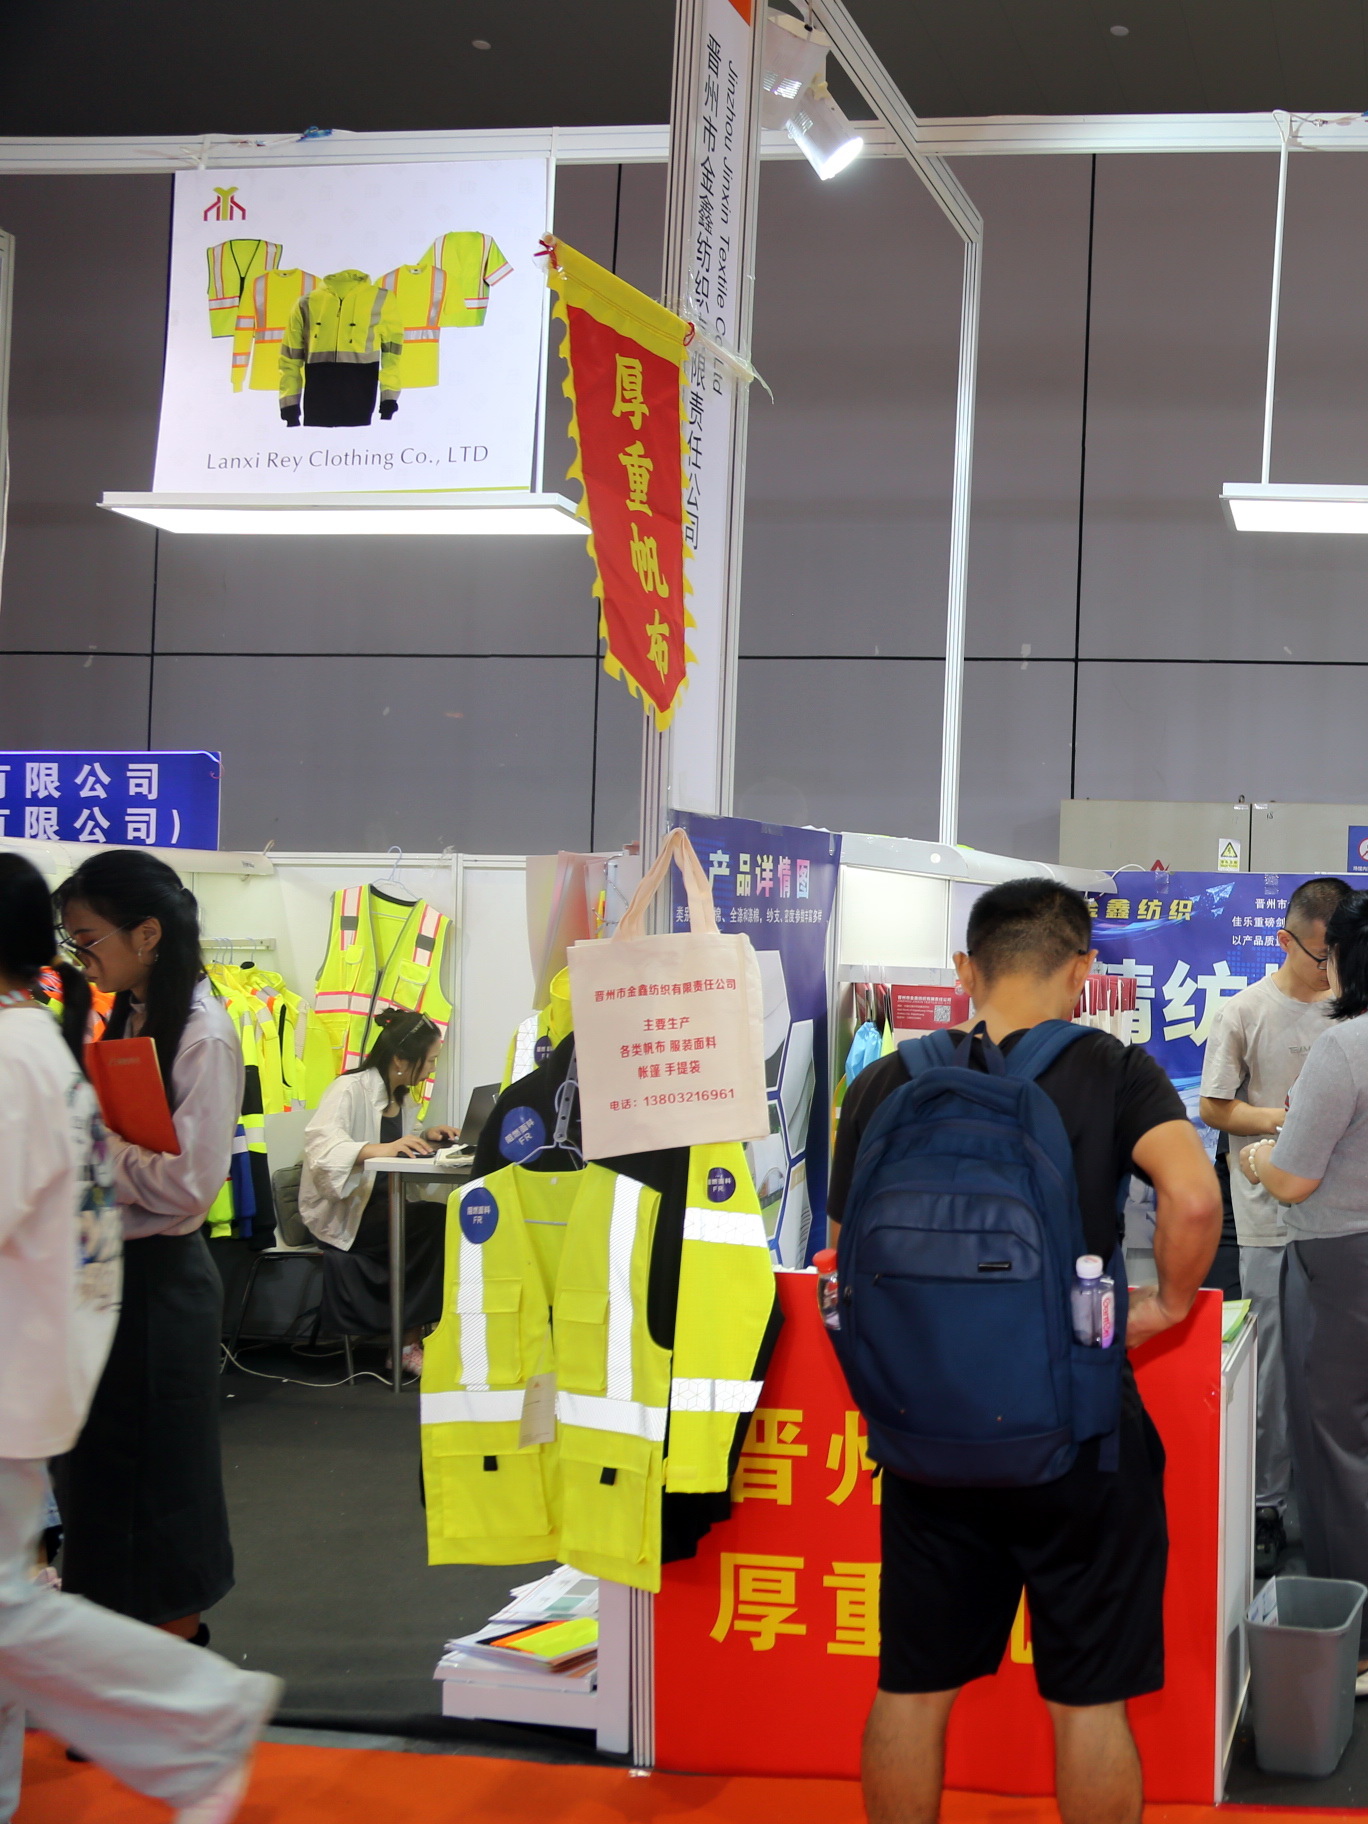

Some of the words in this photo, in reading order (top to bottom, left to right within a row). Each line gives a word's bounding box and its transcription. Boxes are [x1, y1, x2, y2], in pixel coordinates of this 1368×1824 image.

[724, 60, 738, 152] Jinzhou
[720, 156, 734, 224] Jinxin
[716, 235, 730, 309] Textile
[712, 356, 725, 396] Ltd
[207, 452, 260, 470] Lanxi
[267, 452, 303, 473] Rey
[308, 448, 394, 471] Clothing
[448, 445, 489, 463] LTD
[612, 353, 671, 685] 厚重帆布
[708, 849, 811, 900] 产品详情图
[594, 978, 737, 1003] 晋州市金鑫纺织有限责任公司
[643, 1016, 691, 1032] 主要生产
[620, 1040, 666, 1059] 各类帆布
[669, 1035, 717, 1053] 服装面料
[637, 1063, 661, 1080] 帐篷
[665, 1060, 701, 1076] 手提袋
[518, 1132, 533, 1146] FR
[472, 1215, 483, 1225] FR
